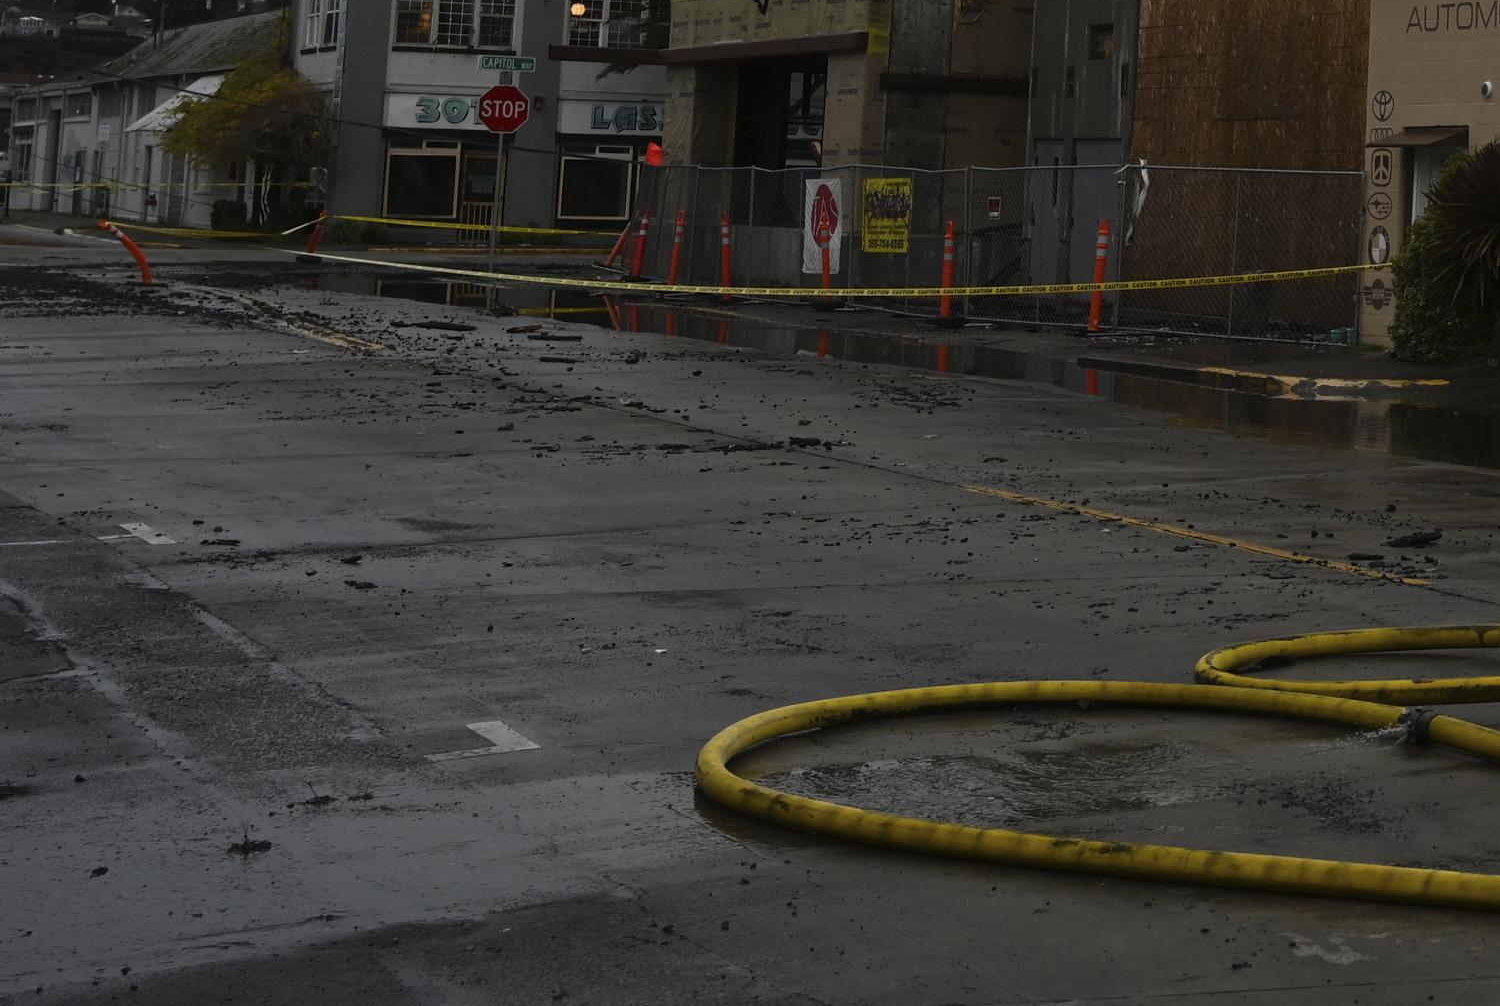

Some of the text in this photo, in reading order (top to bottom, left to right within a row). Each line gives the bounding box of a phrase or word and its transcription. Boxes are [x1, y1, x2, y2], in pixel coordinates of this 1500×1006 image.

[482, 55, 517, 69] CAPITOL
[481, 99, 526, 118] STOP
[590, 103, 664, 133] LAS
[1103, 282, 1128, 290] CAUTION
[1132, 281, 1157, 289] CAUTION
[1160, 279, 1185, 287] CAUTION
[1189, 277, 1214, 285] CAUTION
[1217, 275, 1243, 283] CAUTION
[1247, 273, 1274, 281] CAUTION
[1276, 270, 1304, 279] CAUTION
[1307, 268, 1334, 276] CAUTION
